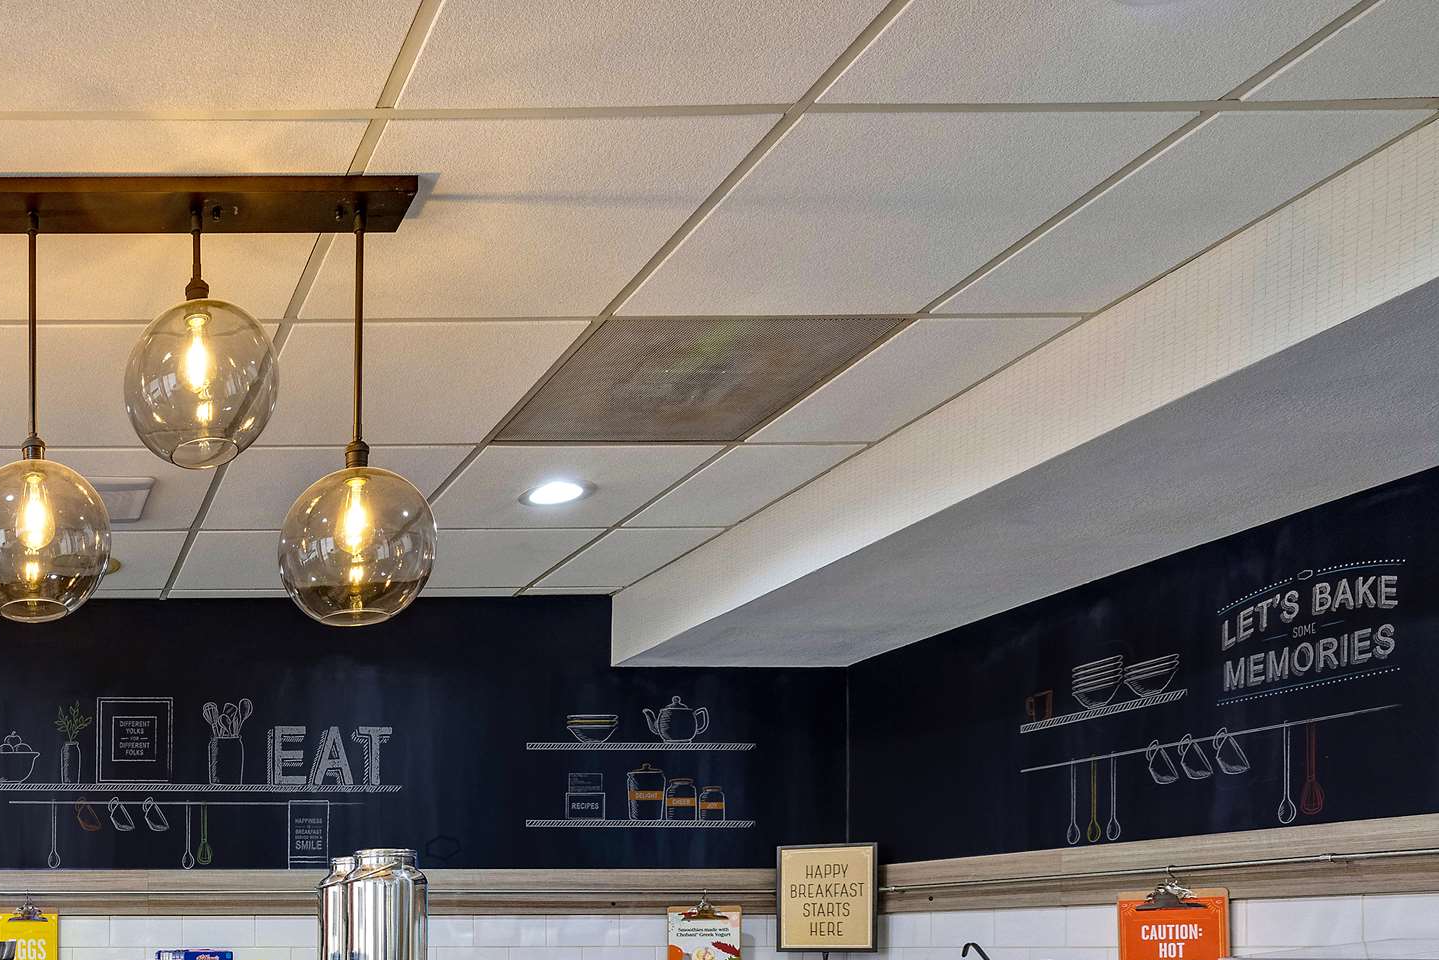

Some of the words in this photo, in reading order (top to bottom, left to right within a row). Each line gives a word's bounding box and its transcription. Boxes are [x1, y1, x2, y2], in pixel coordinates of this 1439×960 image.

[1221, 590, 1299, 651] LET'S
[1312, 575, 1399, 616] BAKE
[1292, 622, 1316, 639] SOME
[1223, 623, 1396, 692] MEMORIES
[266, 726, 392, 788] EAT
[571, 802, 600, 811] RECIPES
[295, 840, 322, 850] SMILE
[805, 863, 849, 879] HAPPY
[790, 882, 864, 899] BREAKFAST
[802, 902, 850, 918] STARTS
[809, 921, 844, 937] HERE
[1141, 923, 1203, 941] CAUTION:
[7, 937, 47, 960] GGS
[1158, 942, 1185, 959] HOT
